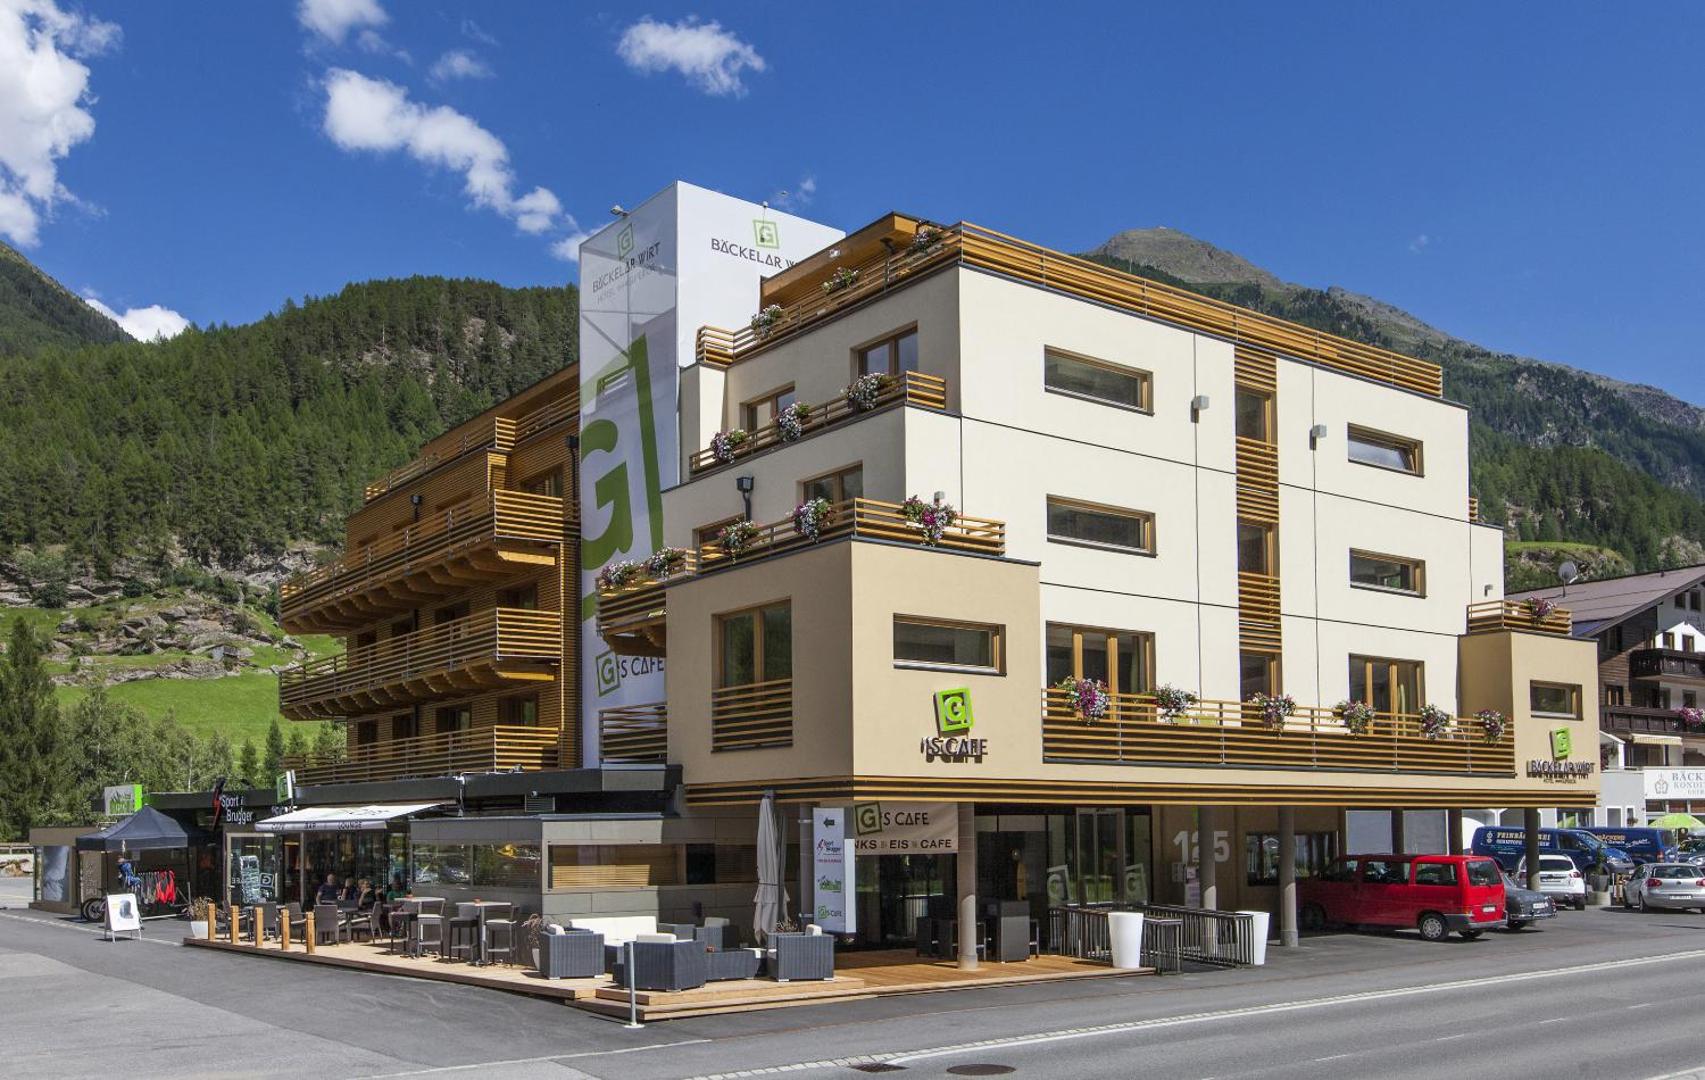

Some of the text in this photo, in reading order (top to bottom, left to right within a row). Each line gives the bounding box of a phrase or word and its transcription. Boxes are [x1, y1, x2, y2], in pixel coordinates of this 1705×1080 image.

[638, 241, 661, 265] WIRT
[711, 237, 782, 269] BÄCKELAR
[221, 795, 239, 807] Sport
[226, 809, 253, 825] Brugger
[895, 812, 930, 826] CAFE
[889, 839, 909, 849] EIS
[920, 839, 952, 849] CAFE
